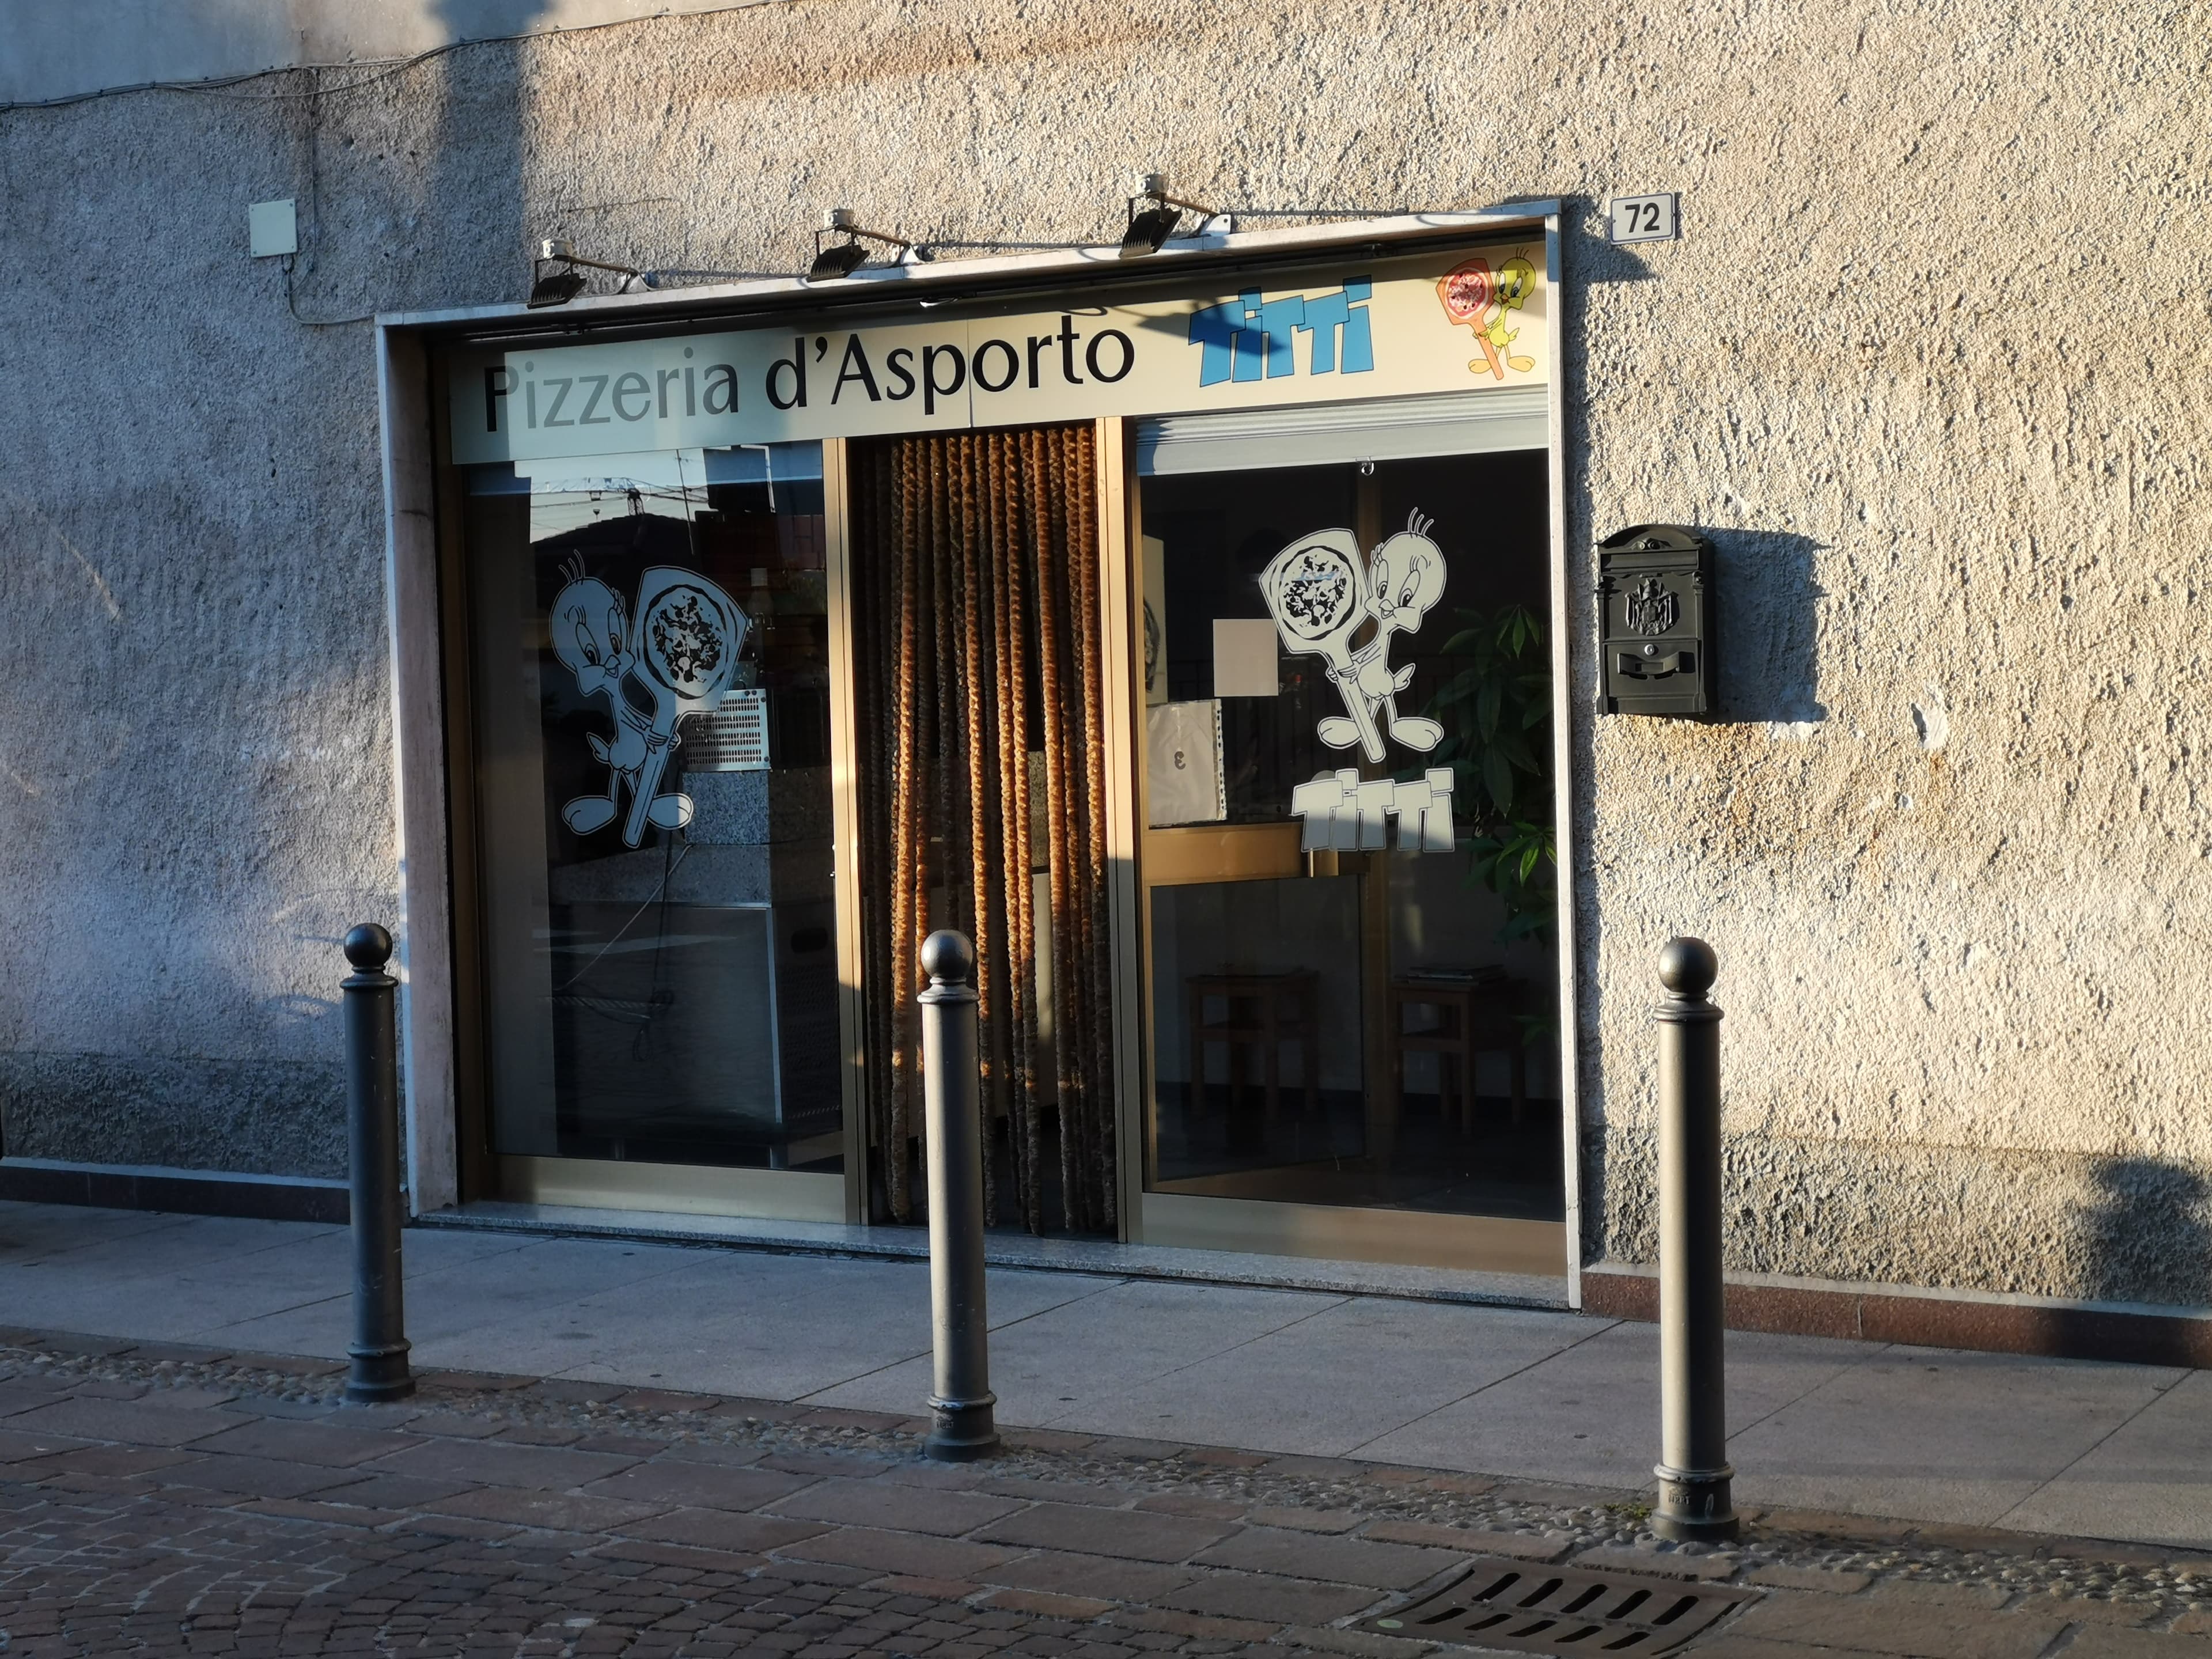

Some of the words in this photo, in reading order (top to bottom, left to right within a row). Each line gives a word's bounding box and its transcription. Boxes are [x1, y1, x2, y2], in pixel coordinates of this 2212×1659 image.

[1624, 202, 1660, 233] 72
[484, 347, 739, 432] Pizzeria
[765, 315, 1135, 415] d'Asporto
